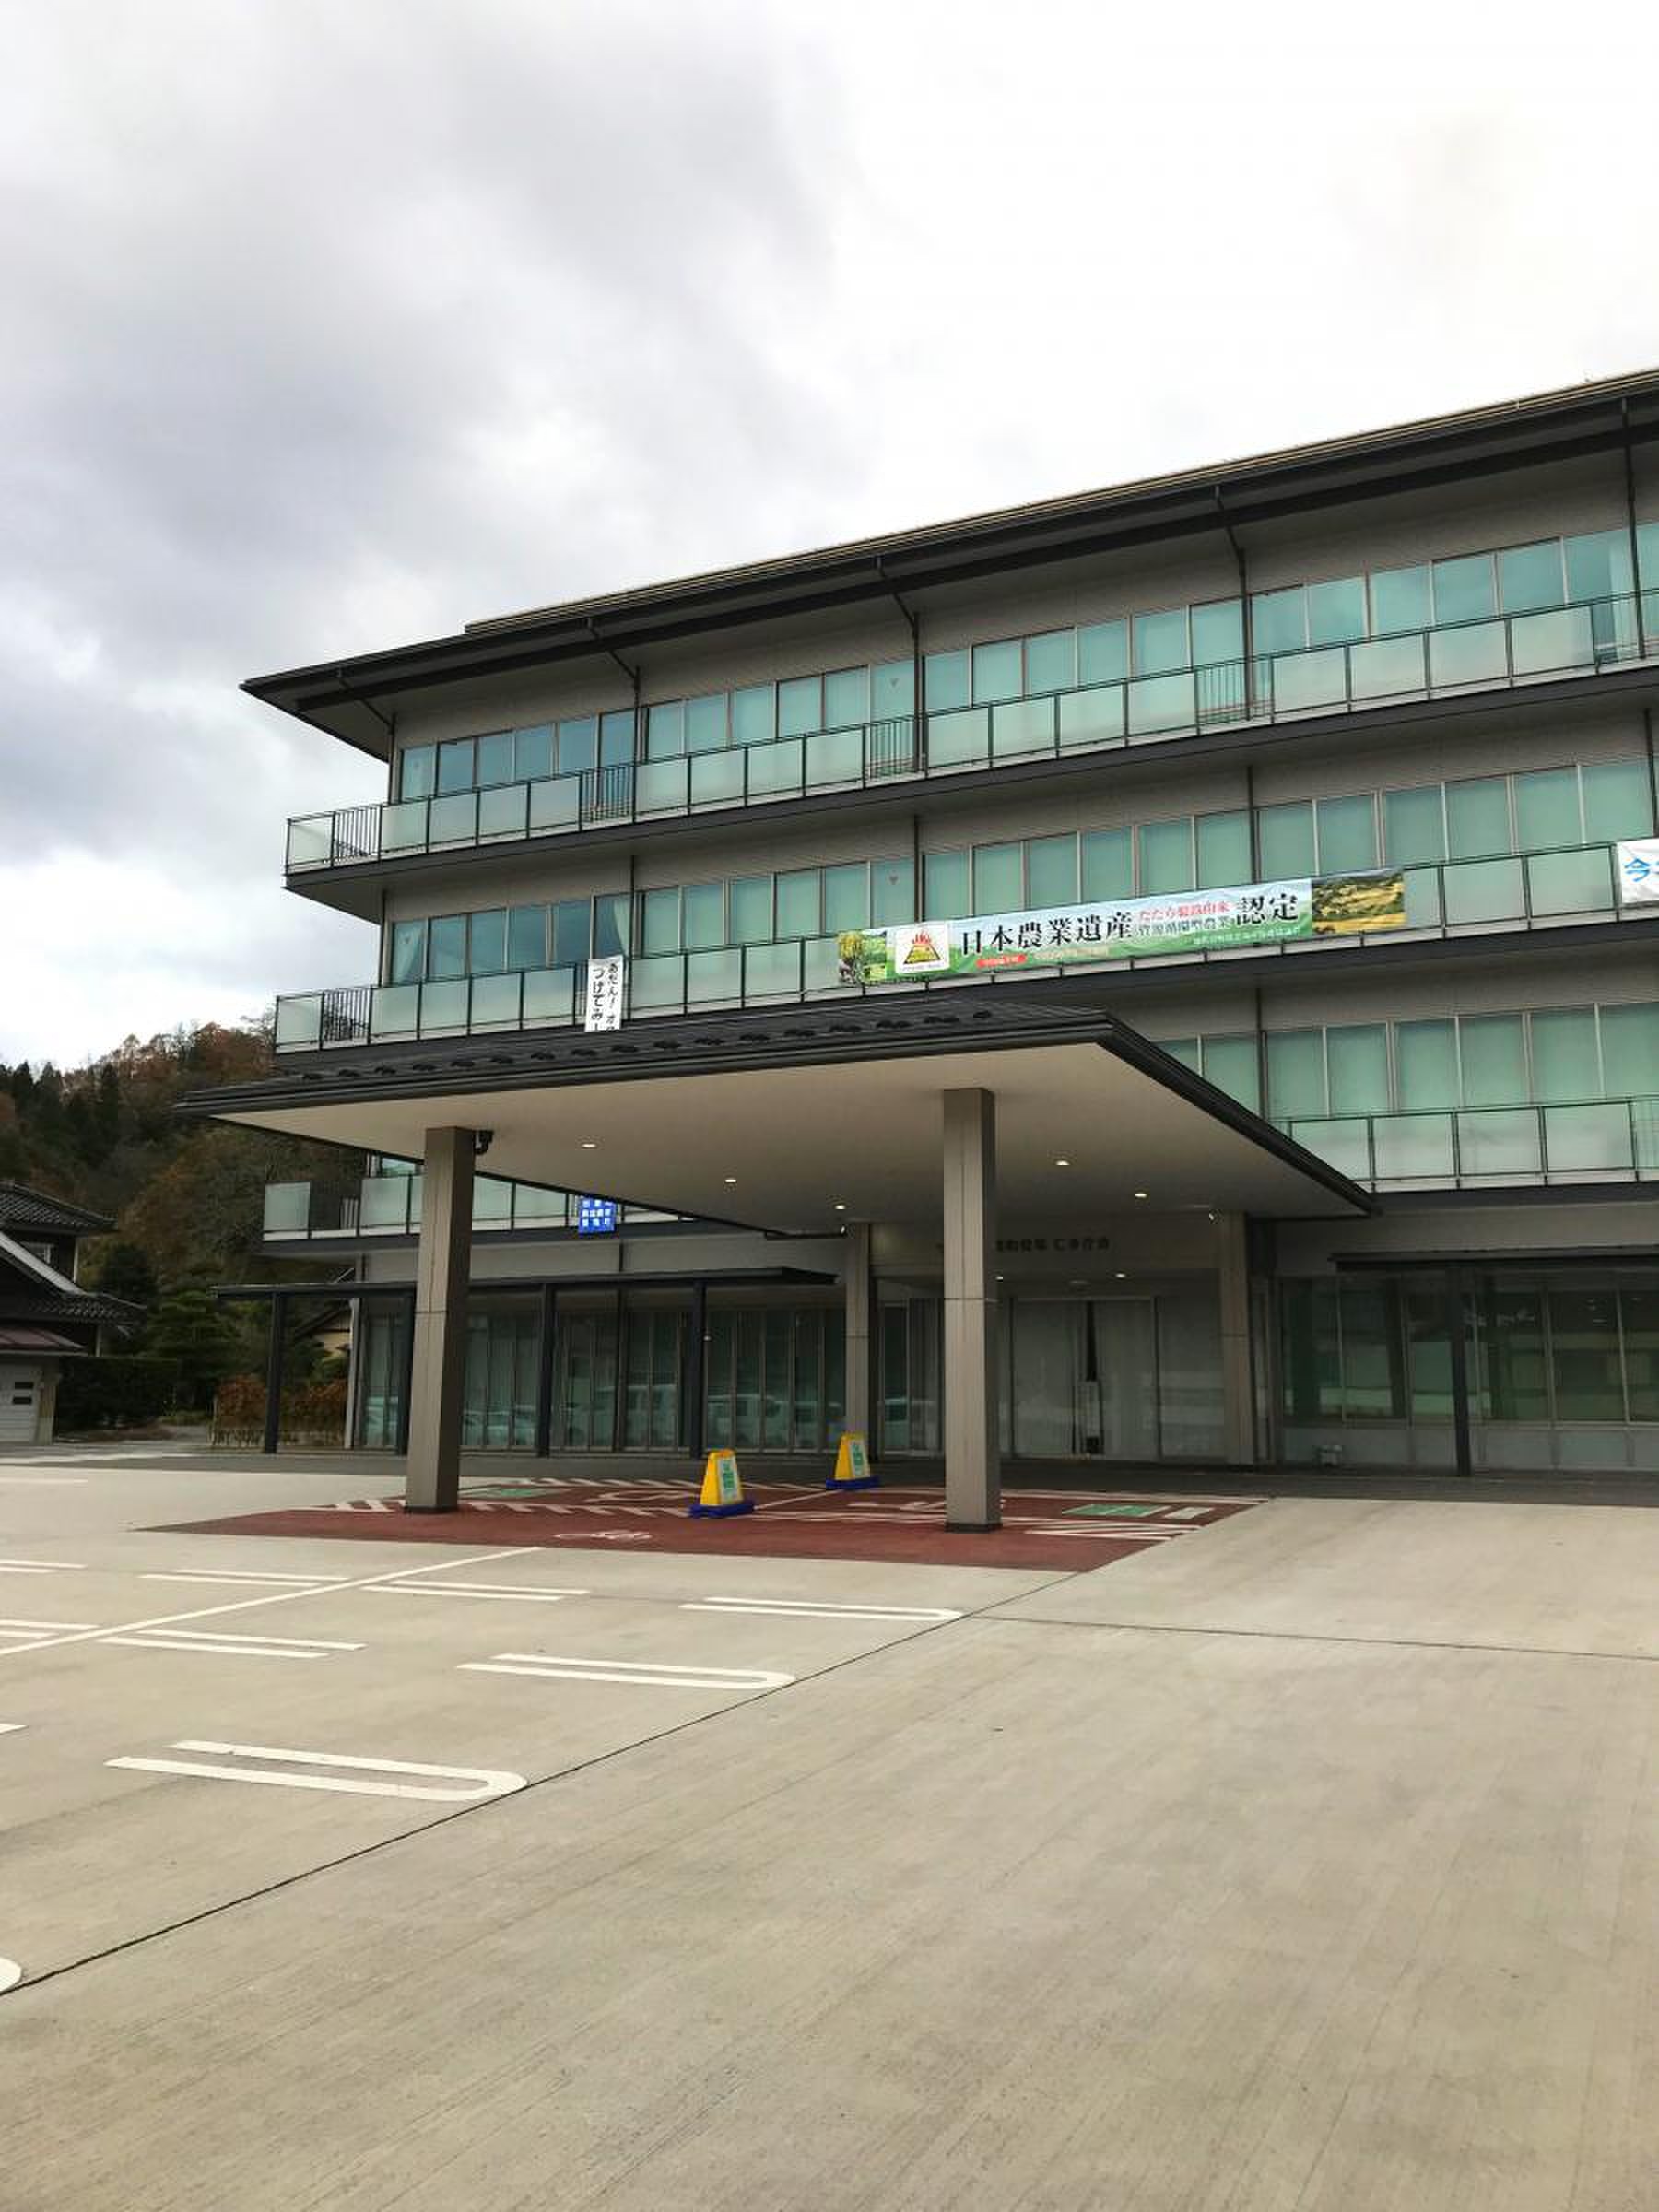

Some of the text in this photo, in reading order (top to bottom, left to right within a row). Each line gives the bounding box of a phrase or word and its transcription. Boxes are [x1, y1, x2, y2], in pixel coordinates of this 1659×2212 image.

[1234, 892, 1299, 925] 認定
[961, 911, 1132, 955] 日本農業遺産
